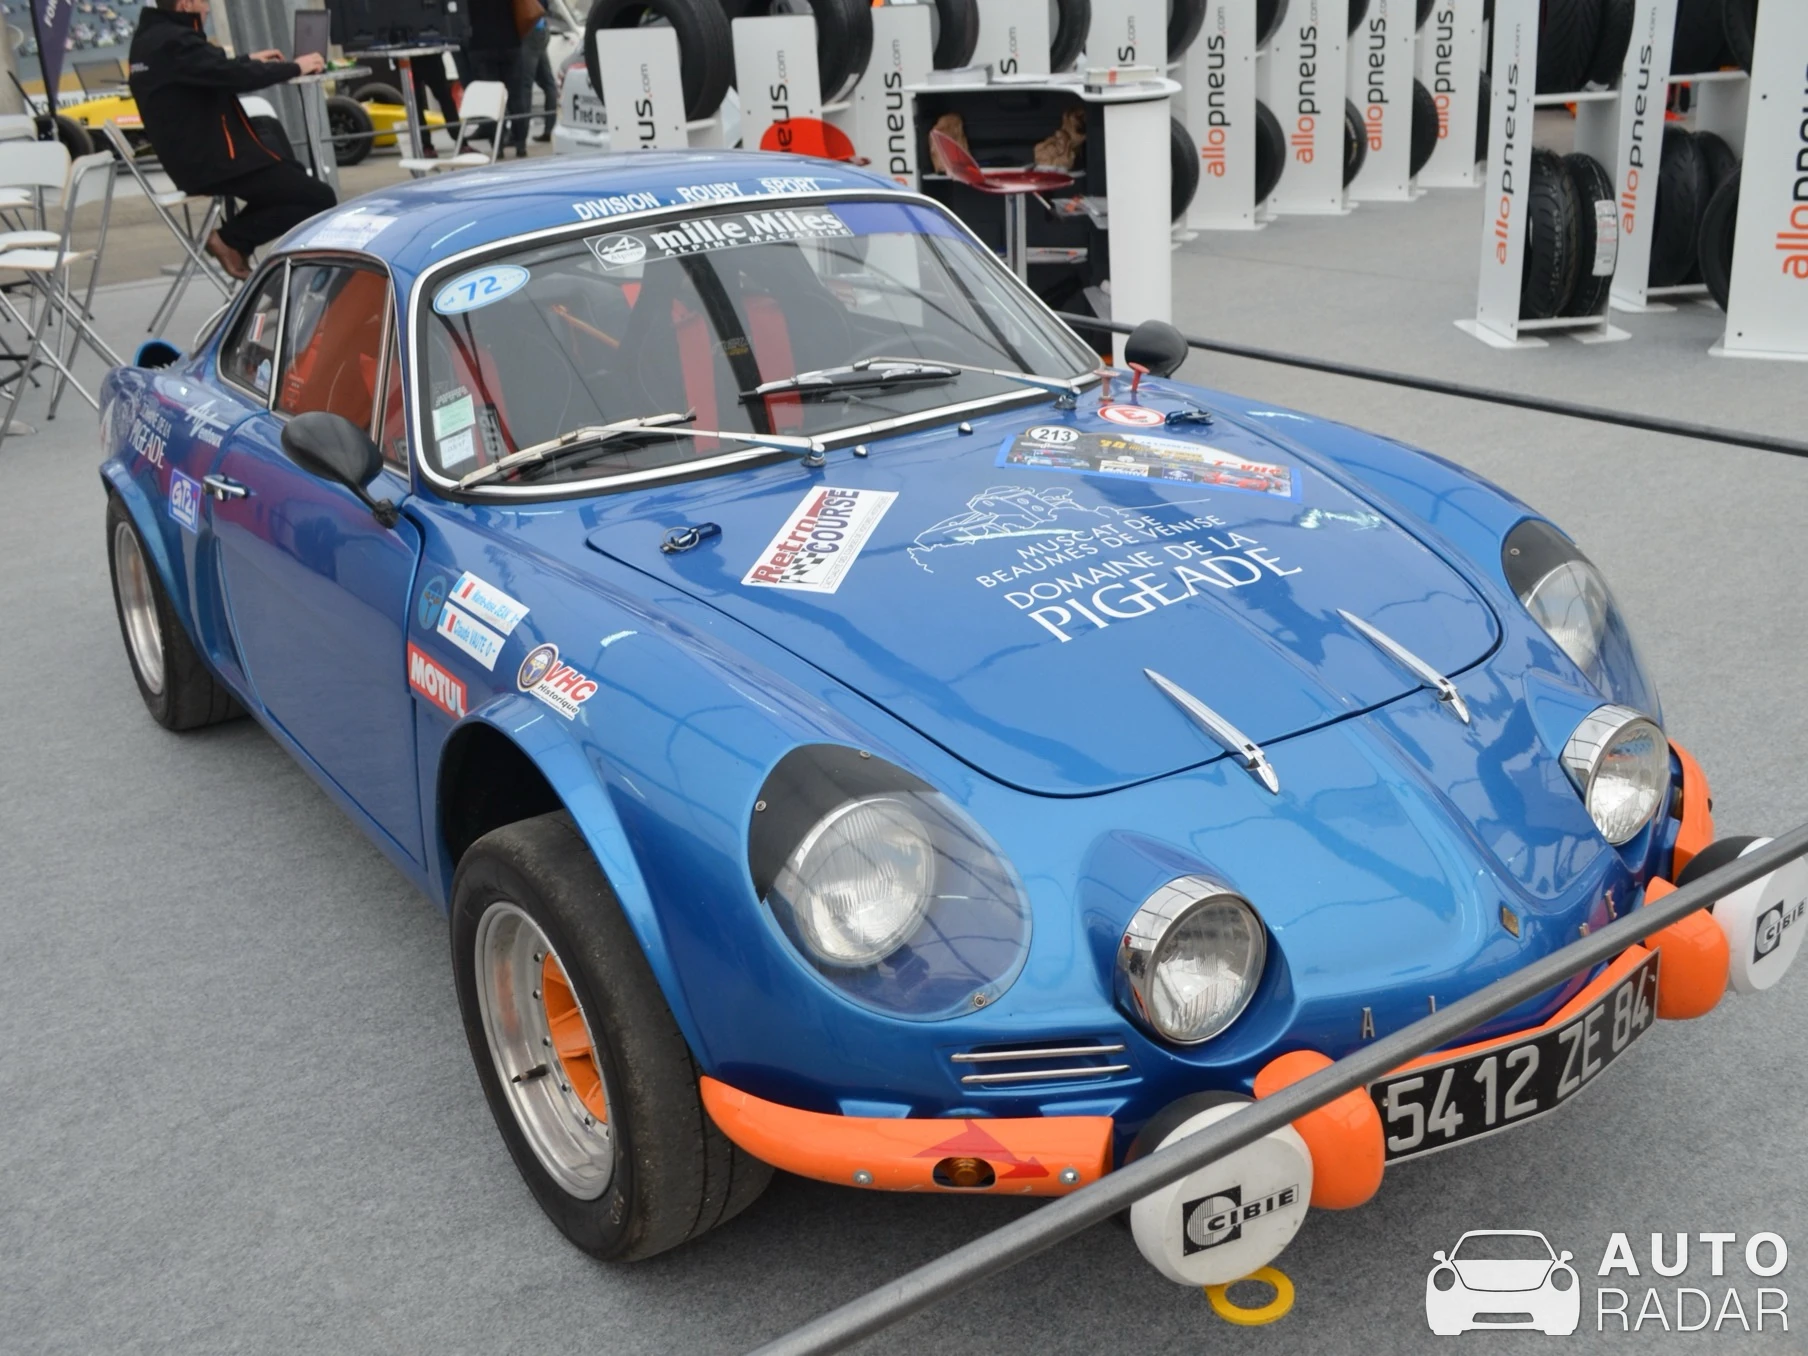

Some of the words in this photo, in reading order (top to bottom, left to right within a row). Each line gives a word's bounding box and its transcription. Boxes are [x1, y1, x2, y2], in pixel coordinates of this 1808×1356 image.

[1202, 5, 1232, 178] allopneus.com
[573, 192, 661, 221] DIVISION
[676, 182, 744, 203] ROUBY
[760, 177, 823, 194] SPORT
[650, 219, 747, 250] mille
[743, 210, 843, 236] Miles
[664, 239, 740, 256] ALPINE
[749, 228, 850, 243] MAGAZINE
[458, 276, 503, 301] 72
[1038, 428, 1072, 442] 213
[806, 489, 860, 554] COURSE
[1016, 523, 1118, 560] MUSCAT
[1123, 515, 1155, 531] DE
[750, 517, 819, 584] Retro
[975, 543, 1099, 588] BEAUMES
[1100, 532, 1132, 549] DE
[1137, 513, 1227, 540] VENISE
[1004, 551, 1164, 610] DOMAINE
[1163, 540, 1213, 561] DE
[1208, 531, 1259, 551] LA
[1027, 547, 1303, 643] PIGEADE
[410, 651, 465, 718] MOTUL
[537, 683, 579, 714] Historique
[544, 661, 597, 702] VHC
[1764, 900, 1805, 941] CIBIE
[1556, 1003, 1605, 1099] ZE
[1611, 965, 1650, 1053] 84
[1207, 1188, 1294, 1231] CIBIE
